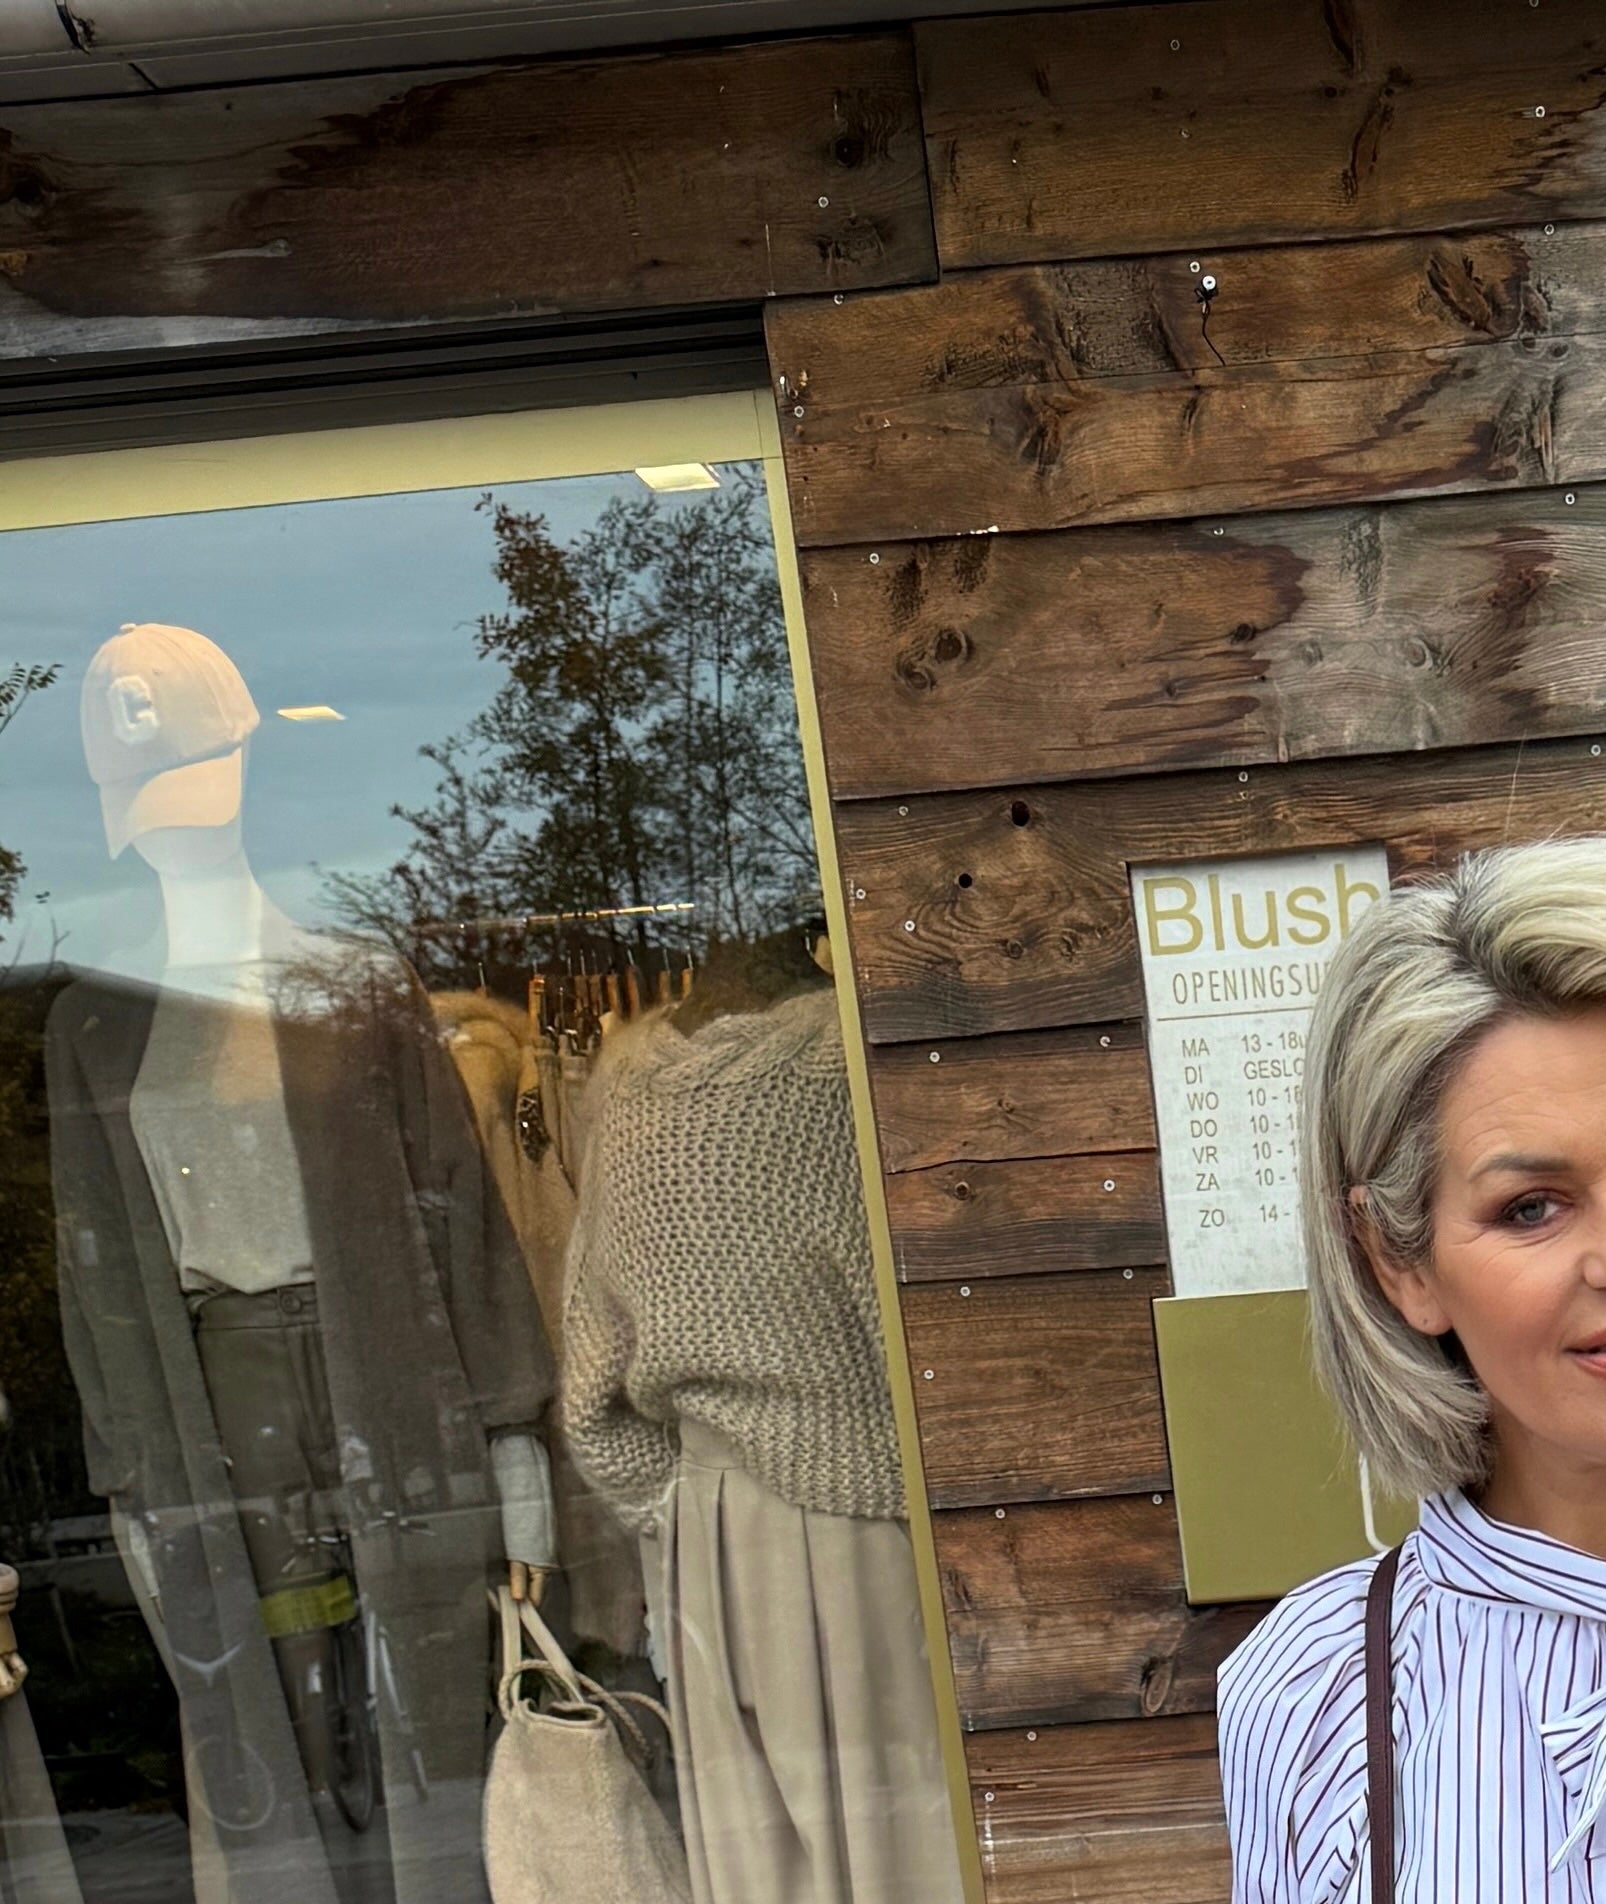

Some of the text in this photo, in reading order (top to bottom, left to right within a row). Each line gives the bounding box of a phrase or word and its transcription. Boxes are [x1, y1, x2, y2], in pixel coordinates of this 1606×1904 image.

[1143, 864, 1382, 957] Blush
[1173, 961, 1331, 1004] OPENINGSU
[1181, 1038, 1211, 1058] MA
[1241, 1033, 1262, 1053] 13
[1185, 1065, 1204, 1085] DI
[1187, 1092, 1219, 1111] WO
[1248, 1088, 1267, 1107] 10
[1190, 1119, 1217, 1138] DO
[1250, 1114, 1269, 1134] 10
[1192, 1146, 1218, 1165] VR
[1252, 1140, 1271, 1161] 10
[1196, 1173, 1220, 1192] ZA
[1255, 1168, 1274, 1187] 10
[1200, 1209, 1225, 1228] ZO
[1259, 1204, 1278, 1223] 14
